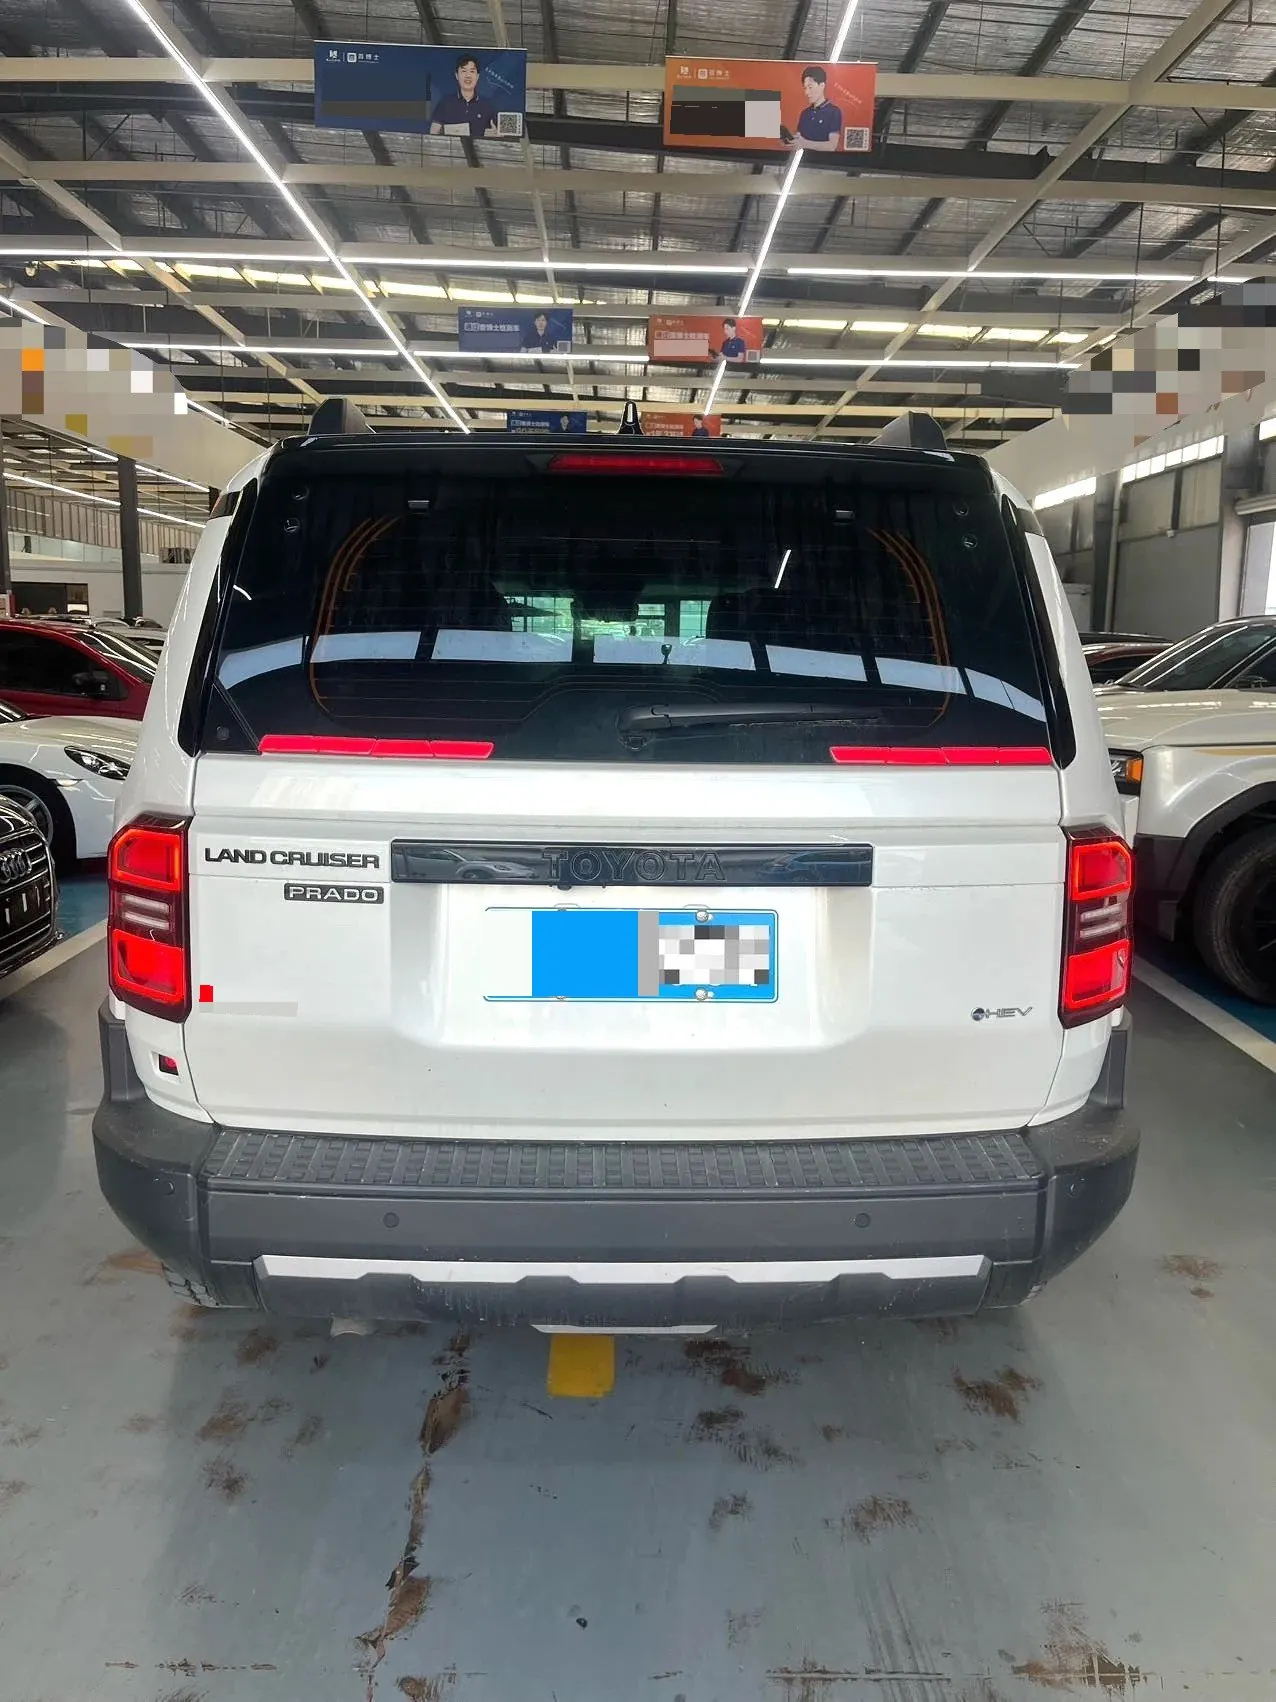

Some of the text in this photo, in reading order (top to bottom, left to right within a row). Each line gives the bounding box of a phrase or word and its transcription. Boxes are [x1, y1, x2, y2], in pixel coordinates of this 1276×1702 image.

[205, 848, 380, 868] LAND CRUISER
[542, 850, 726, 881] TOYOTA
[289, 887, 378, 901] PRADO
[985, 1006, 1033, 1019] HEV
